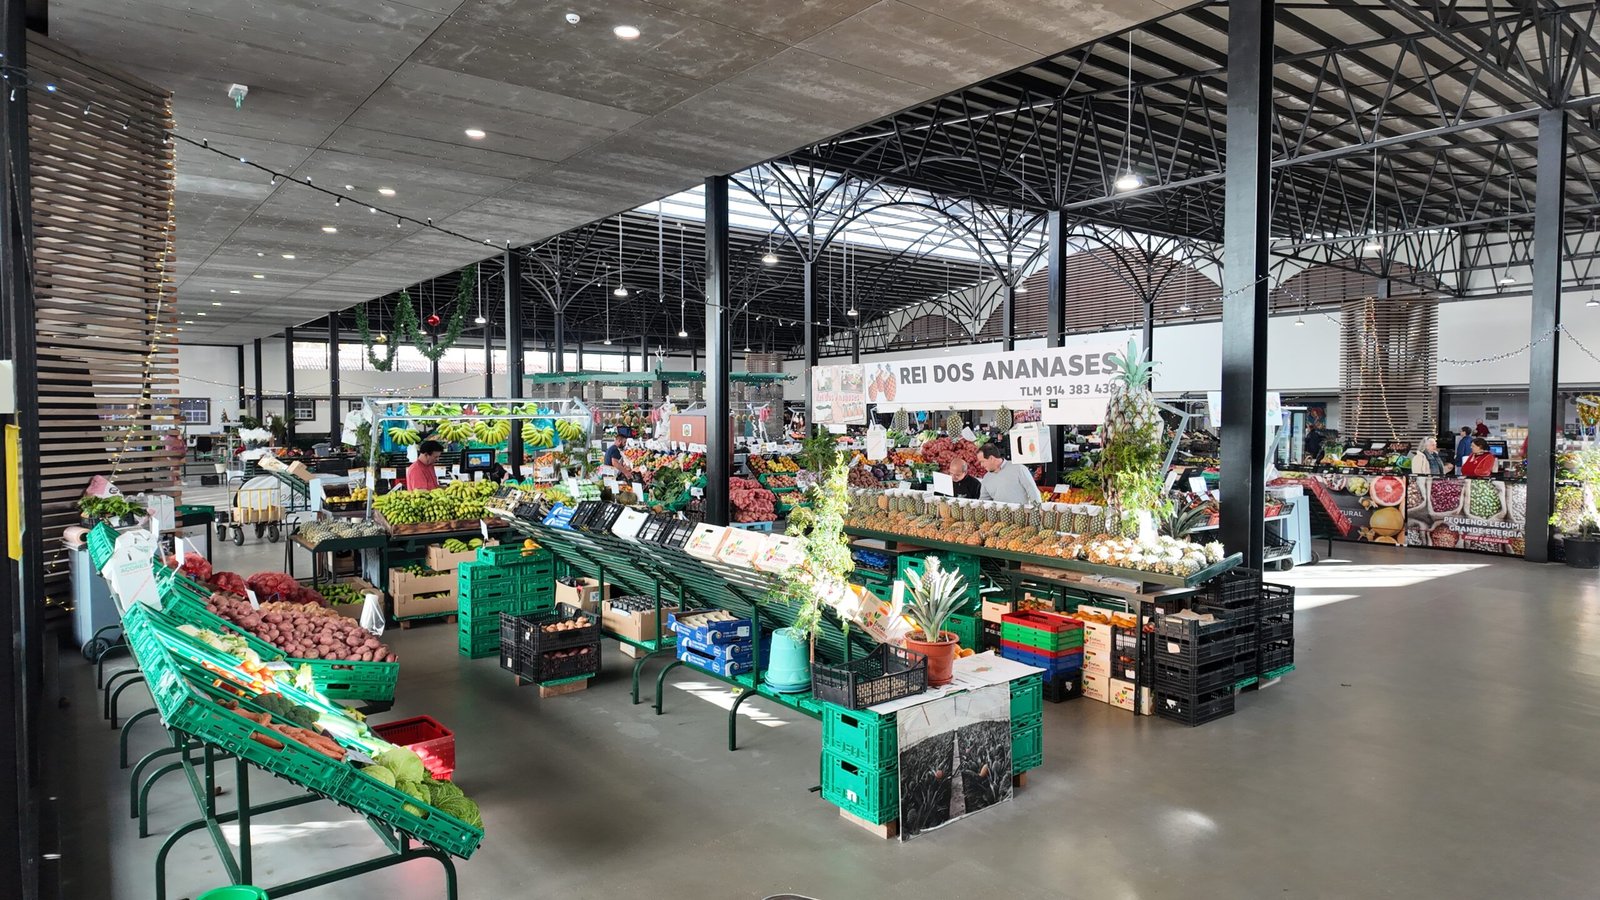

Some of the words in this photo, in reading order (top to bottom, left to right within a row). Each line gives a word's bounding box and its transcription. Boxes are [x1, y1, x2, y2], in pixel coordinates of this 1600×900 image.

[899, 366, 927, 385] REI
[933, 362, 974, 383] DOS
[982, 352, 1118, 381] ANANASES
[1020, 386, 1042, 396] TLM
[1046, 385, 1065, 395] 914
[1069, 384, 1090, 394] 383
[1444, 516, 1488, 527] PEQUENOS
[1490, 521, 1525, 530] LEGUME
[1449, 525, 1484, 534] GRANDE
[1485, 528, 1523, 538] ENERGIA
